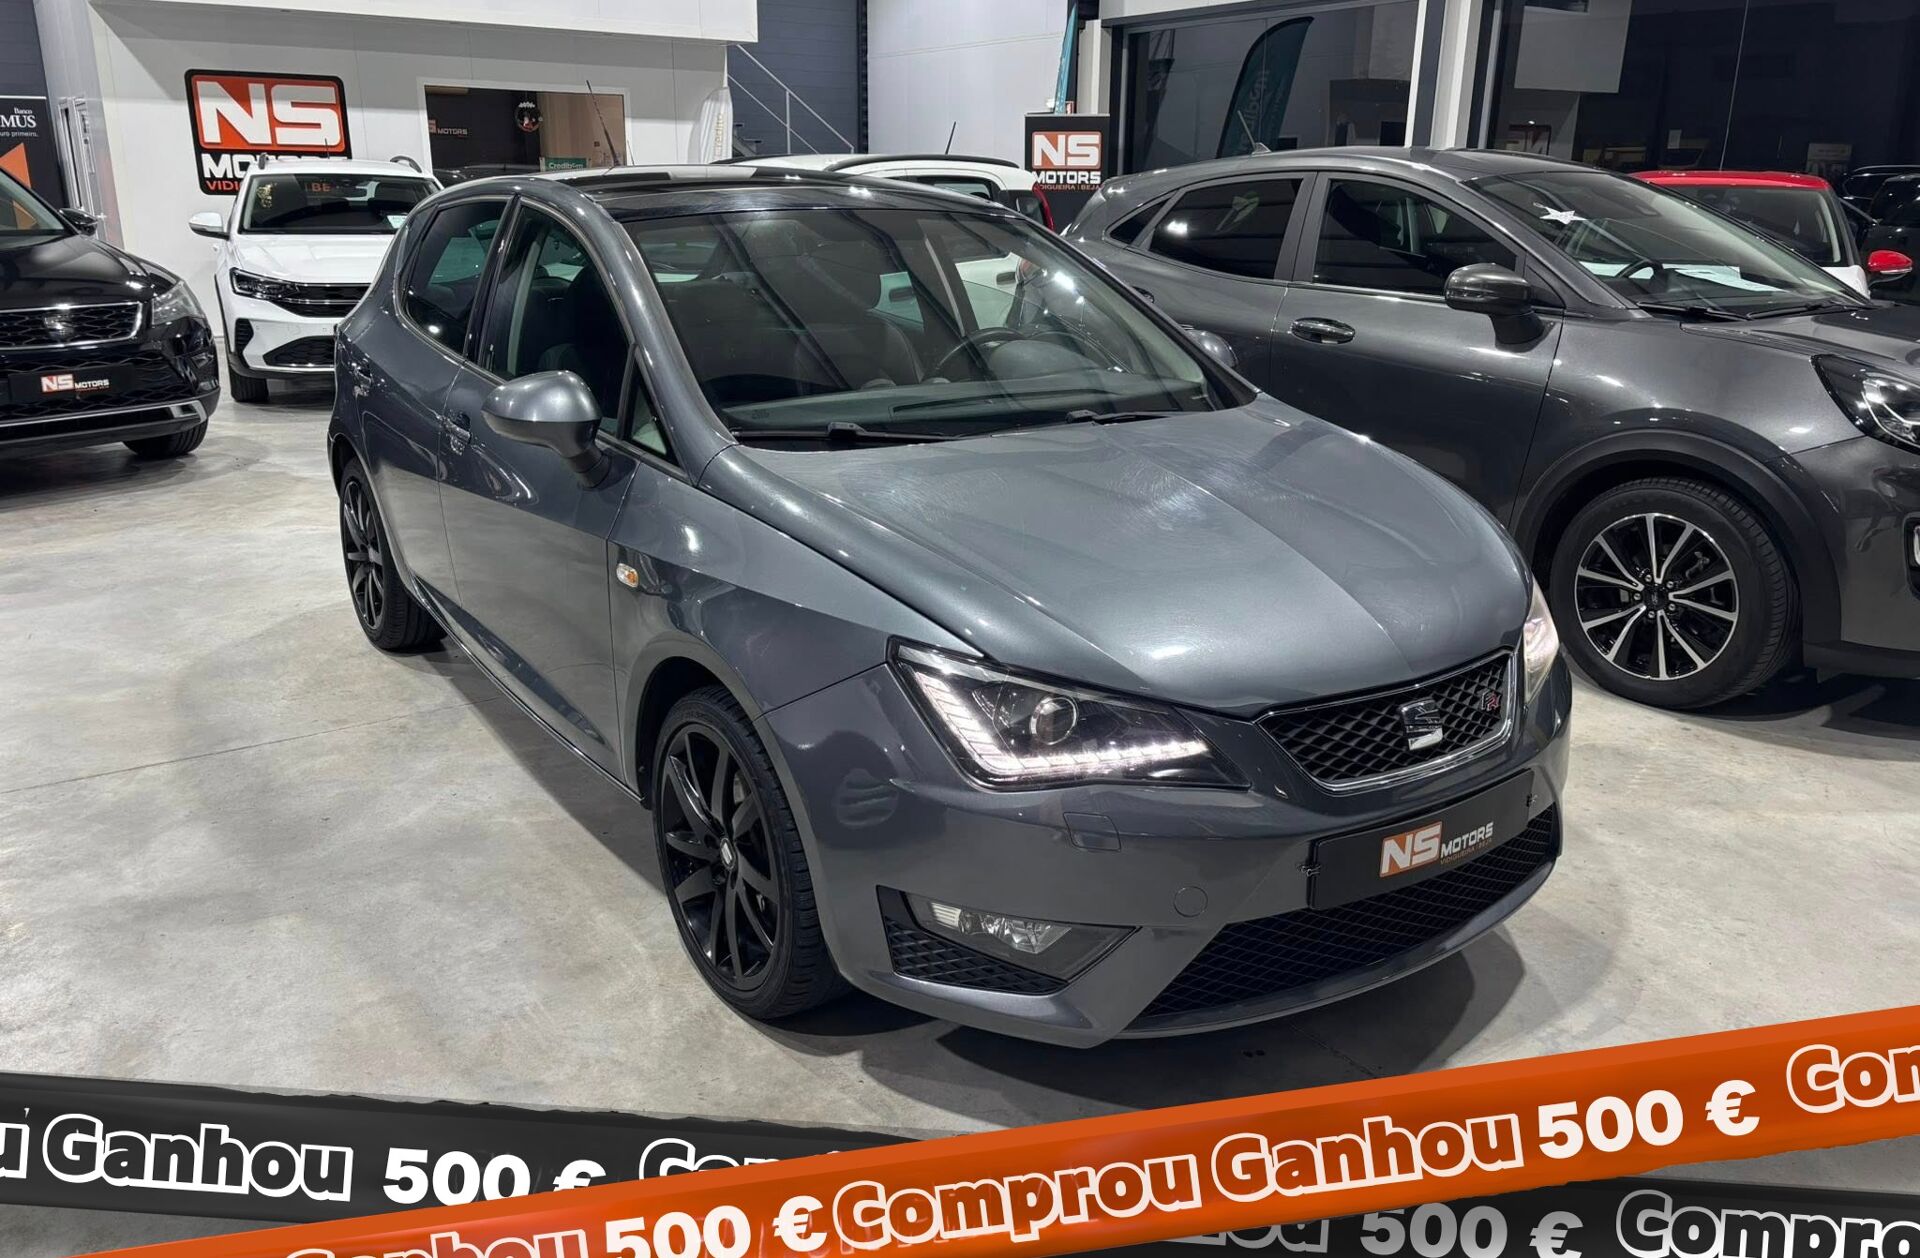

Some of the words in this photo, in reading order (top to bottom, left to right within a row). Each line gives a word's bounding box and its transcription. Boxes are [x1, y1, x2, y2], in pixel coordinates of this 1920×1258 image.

[196, 81, 341, 146] NS
[437, 127, 468, 135] MOTORS
[1033, 134, 1100, 166] NS
[1033, 171, 1102, 185] MOTORS
[41, 374, 74, 392] NS
[74, 379, 110, 389] MOTORS
[1381, 823, 1442, 876] NS
[1440, 821, 1494, 859] MOTORS
